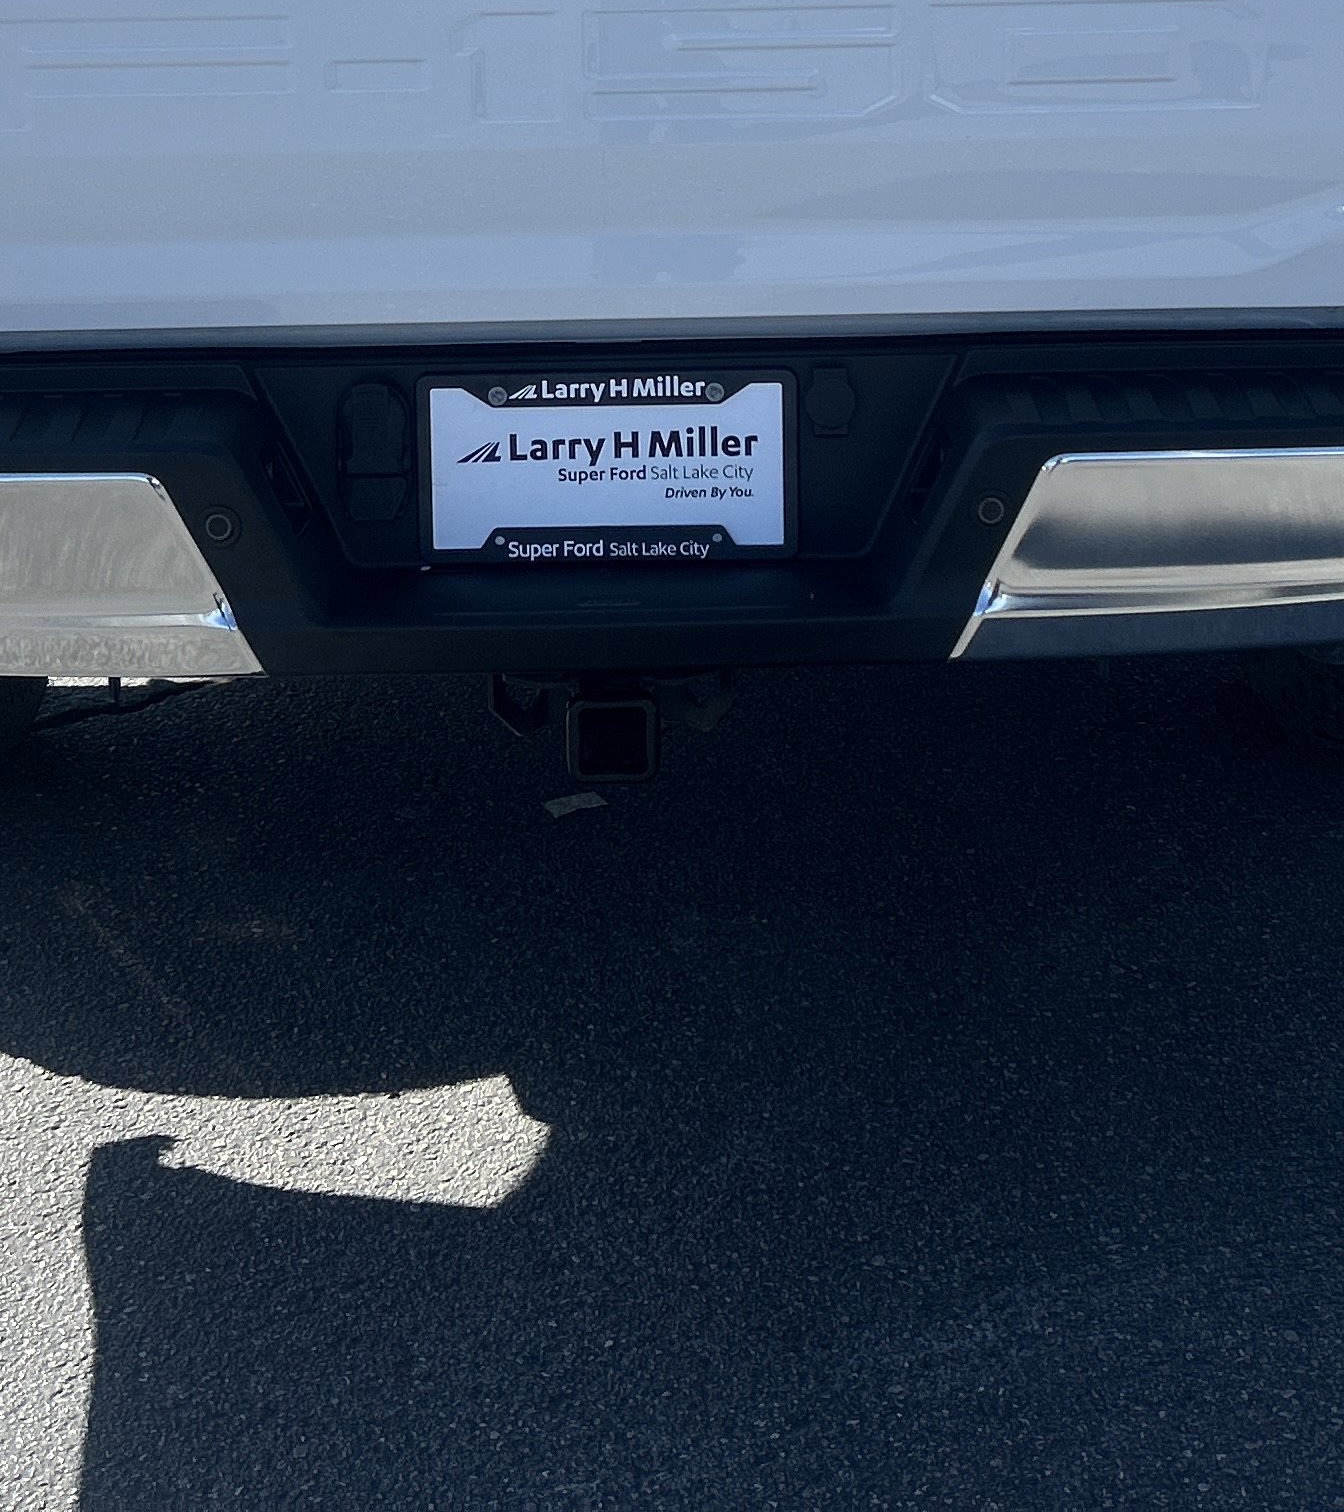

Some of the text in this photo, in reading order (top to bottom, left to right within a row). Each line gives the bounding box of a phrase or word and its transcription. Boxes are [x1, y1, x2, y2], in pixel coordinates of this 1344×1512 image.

[541, 375, 706, 403] Larry H Miller
[509, 426, 759, 467] Larry H Miller
[558, 464, 754, 485] Super Ford Salt Lake City
[665, 487, 707, 499] Driven
[710, 487, 727, 501] By
[508, 539, 710, 561] Super Ford Salt Lake City
